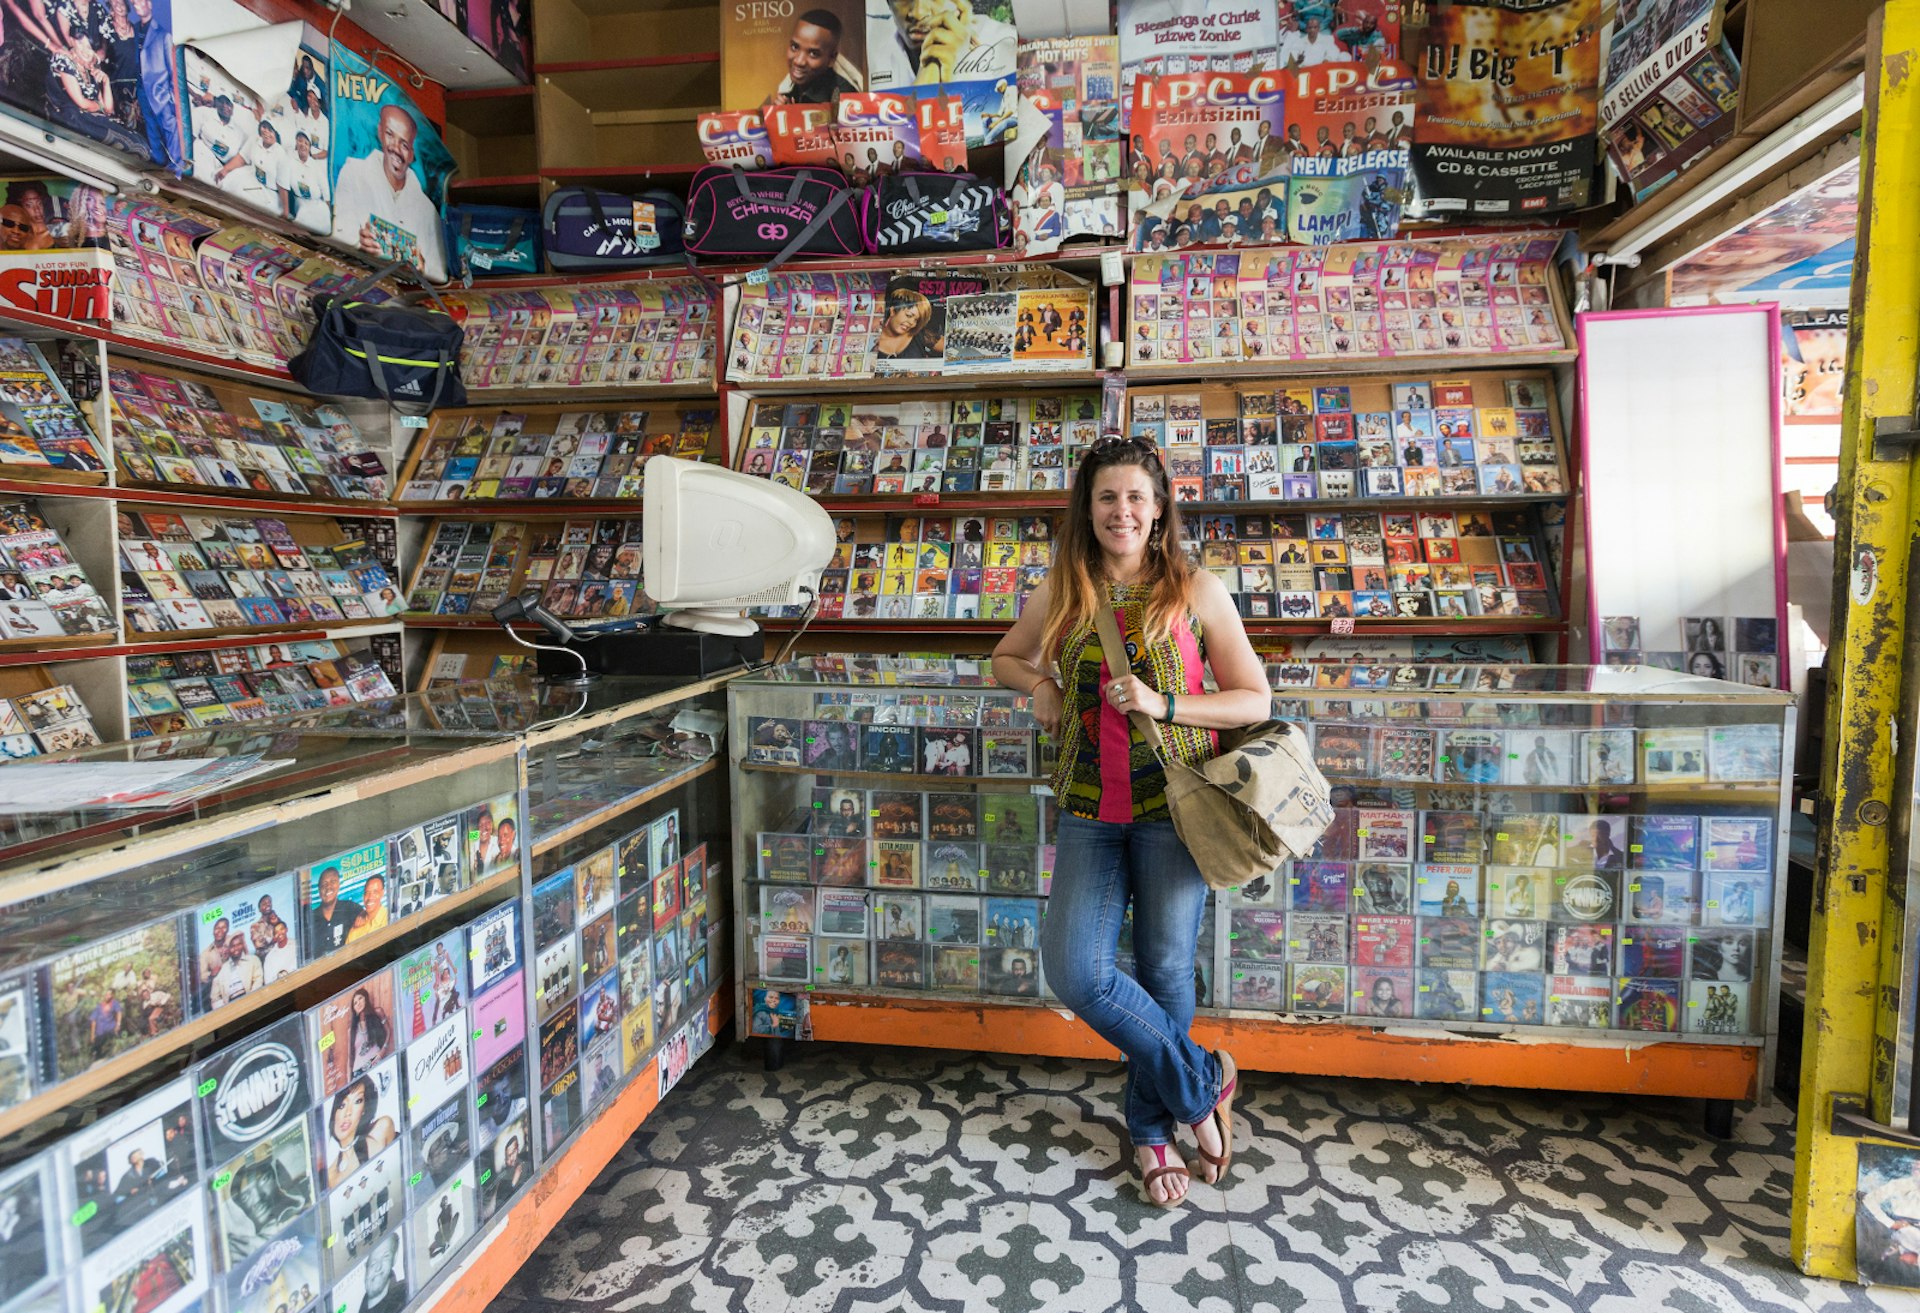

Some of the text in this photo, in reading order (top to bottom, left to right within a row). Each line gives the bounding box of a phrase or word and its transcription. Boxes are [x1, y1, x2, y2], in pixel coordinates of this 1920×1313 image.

[735, 1, 794, 22] S'FISO
[1135, 9, 1260, 35] Blessings of Christ
[1154, 29, 1241, 44] Izizwe Zonke
[1036, 49, 1089, 62] HOT HITS
[1618, 61, 1661, 107] SELLING
[1665, 23, 1709, 70] DVD'S
[1470, 48, 1518, 88] Big
[337, 71, 389, 103] NEW
[1158, 107, 1261, 126] Ezintsizini
[1507, 147, 1546, 161] NOW
[1548, 142, 1573, 155] ON
[1293, 150, 1409, 175] NEW RELEASE
[1436, 161, 1461, 174] CD
[1463, 163, 1475, 174] &
[1523, 198, 1545, 208] EMI
[40, 268, 113, 287] SUNDAY
[340, 845, 384, 869] SOUL
[1426, 865, 1473, 874] PETER TOSH
[1234, 963, 1281, 971] Manhattans
[215, 1061, 298, 1126] SPINNERS
